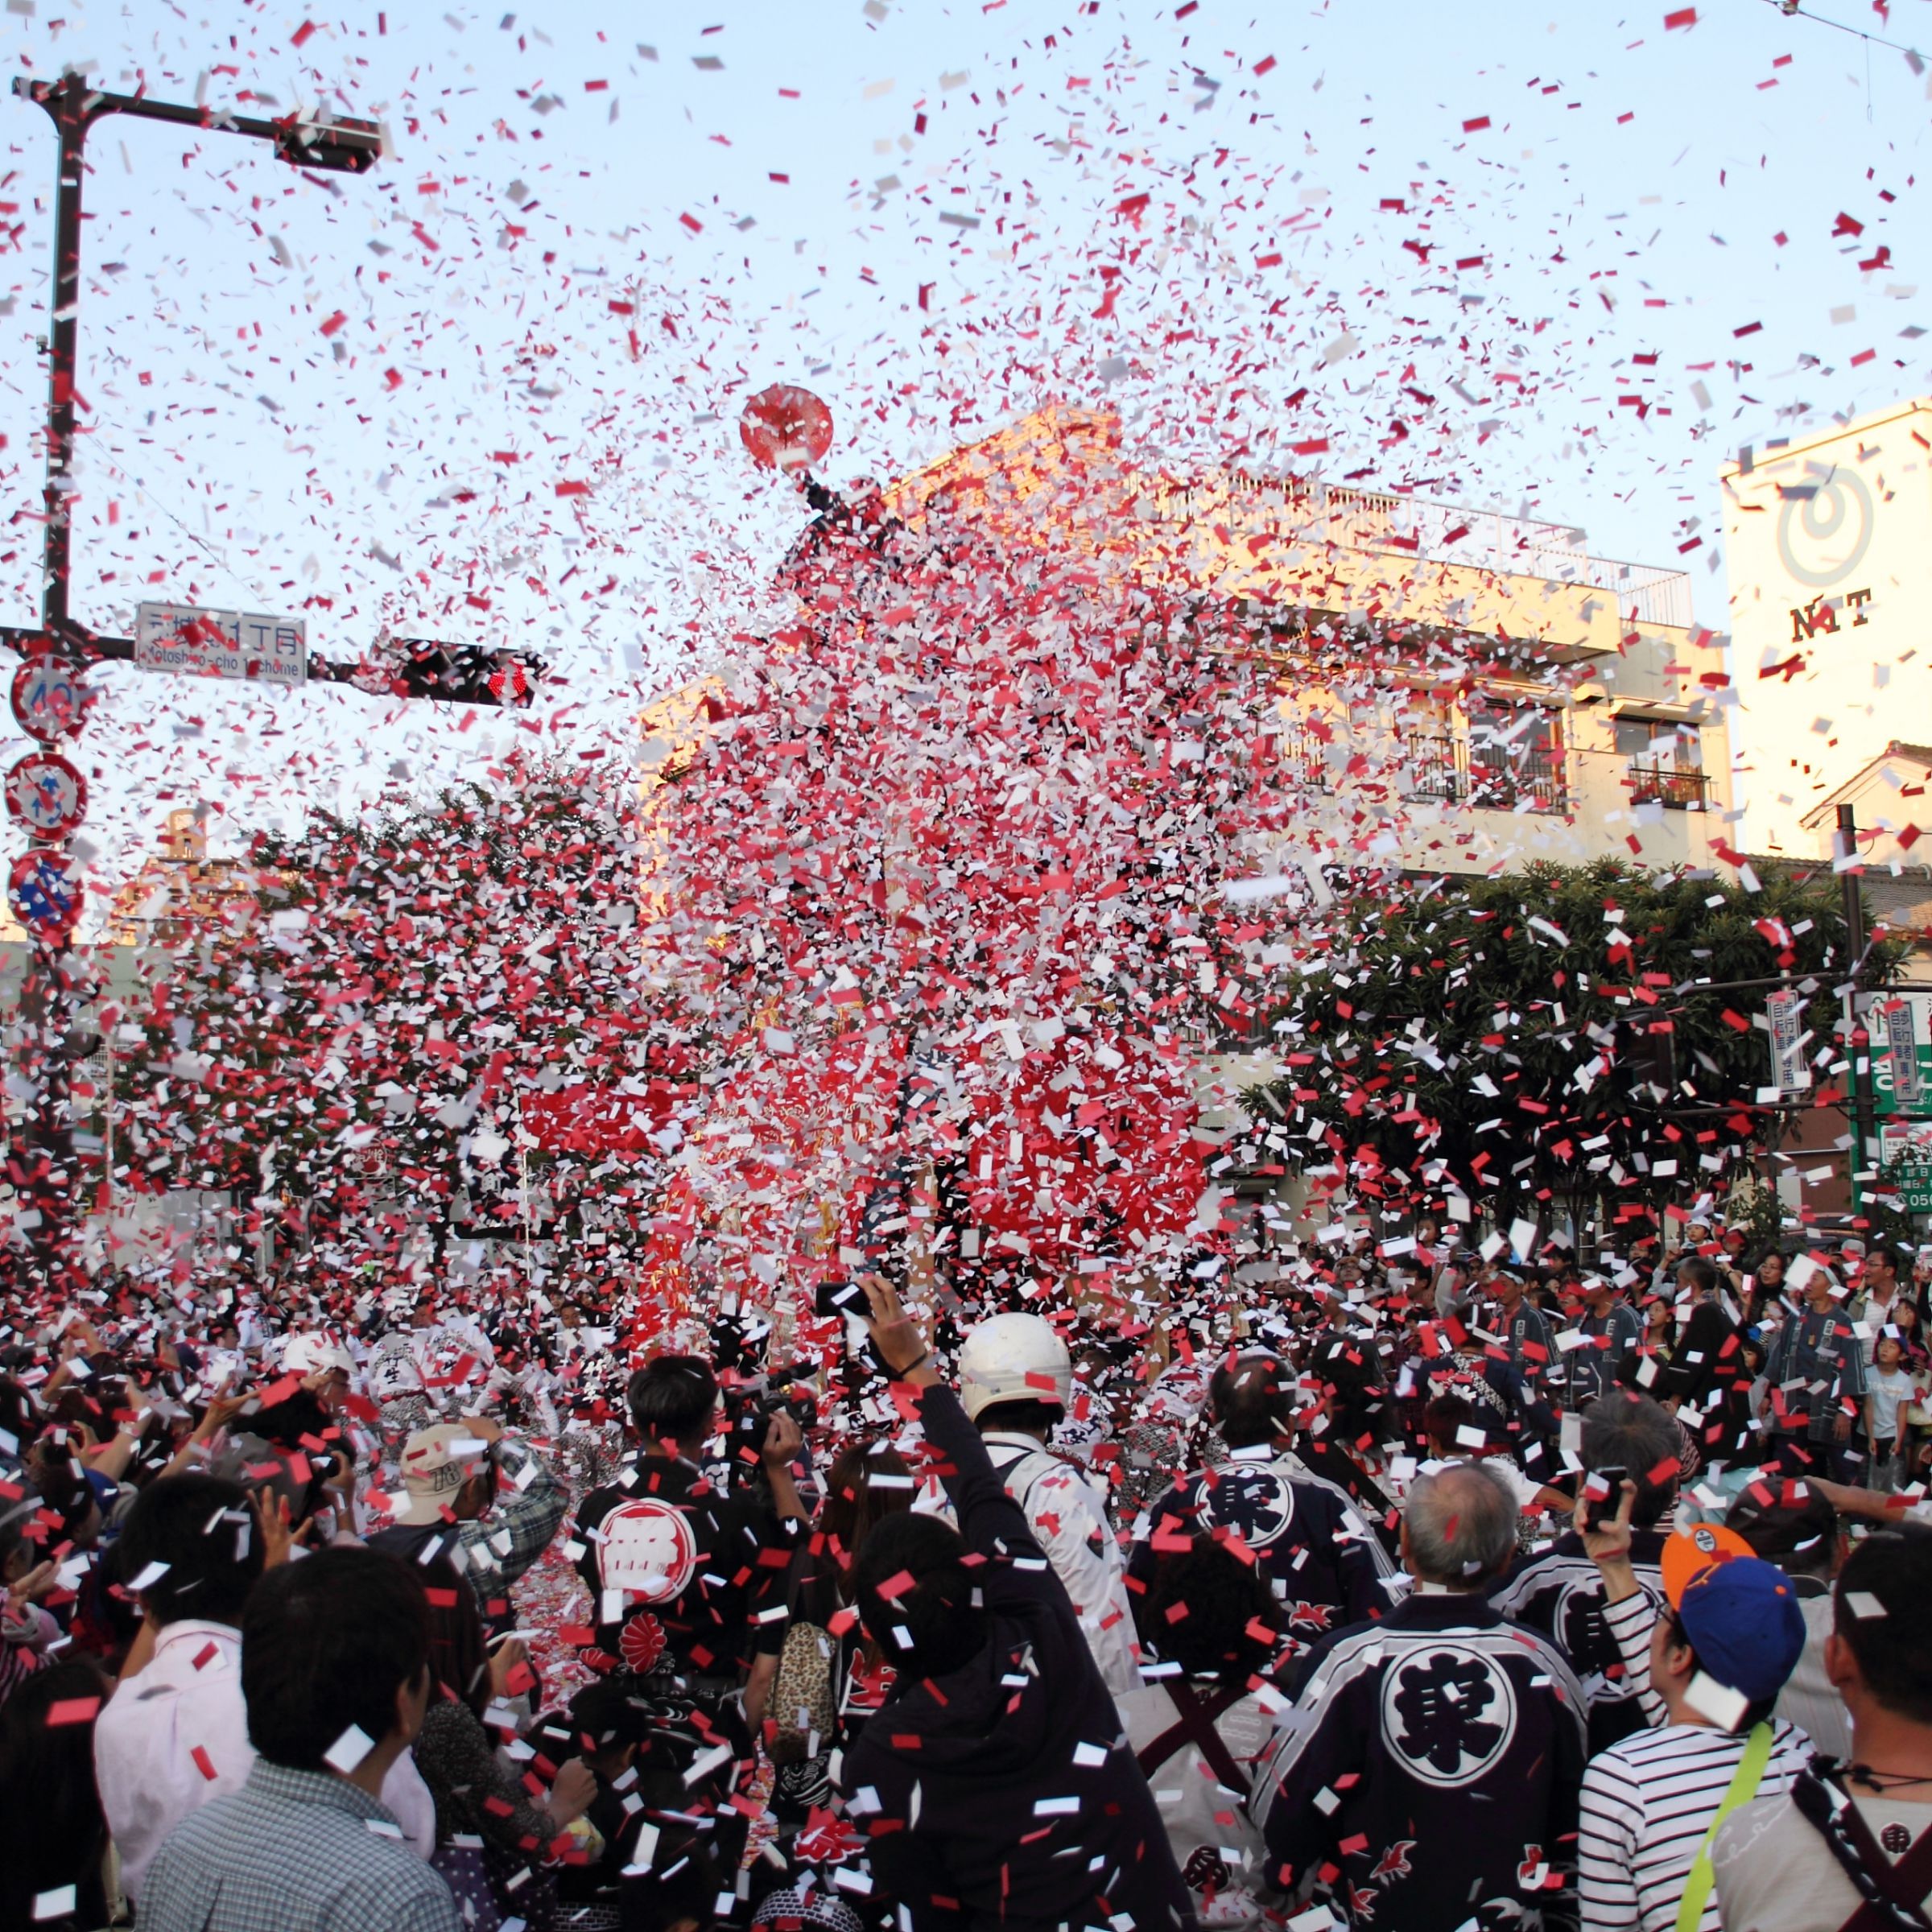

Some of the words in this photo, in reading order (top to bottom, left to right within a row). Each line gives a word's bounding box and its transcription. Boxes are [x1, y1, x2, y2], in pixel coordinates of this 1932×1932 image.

[147, 646, 238, 670] otosho-cho
[243, 657, 299, 676] 1chome
[426, 1460, 461, 1492] 78
